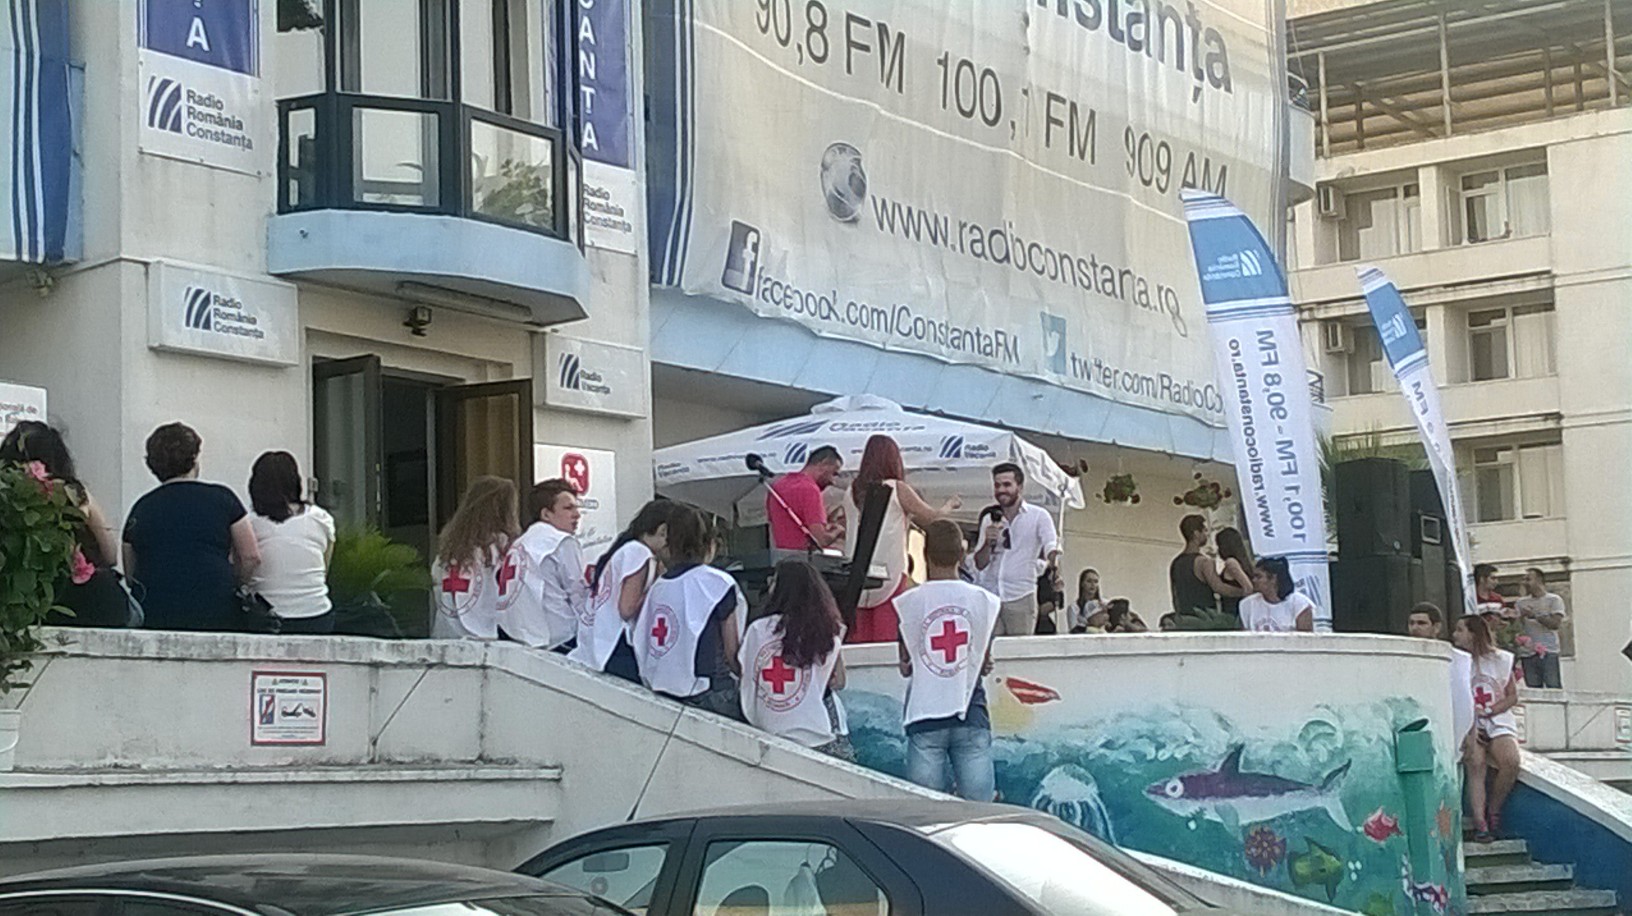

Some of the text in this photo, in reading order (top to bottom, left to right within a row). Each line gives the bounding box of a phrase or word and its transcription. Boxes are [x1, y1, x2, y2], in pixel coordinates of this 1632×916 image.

[186, 0, 210, 52] A
[579, 0, 599, 151] ANTA
[186, 88, 224, 111] Radio
[845, 11, 906, 94] FM
[1045, 90, 1097, 166] FM
[1124, 125, 1172, 195] 909
[1180, 151, 1228, 198] AM
[186, 105, 244, 132] România
[186, 121, 254, 152] Constanța
[213, 294, 243, 310] Radio
